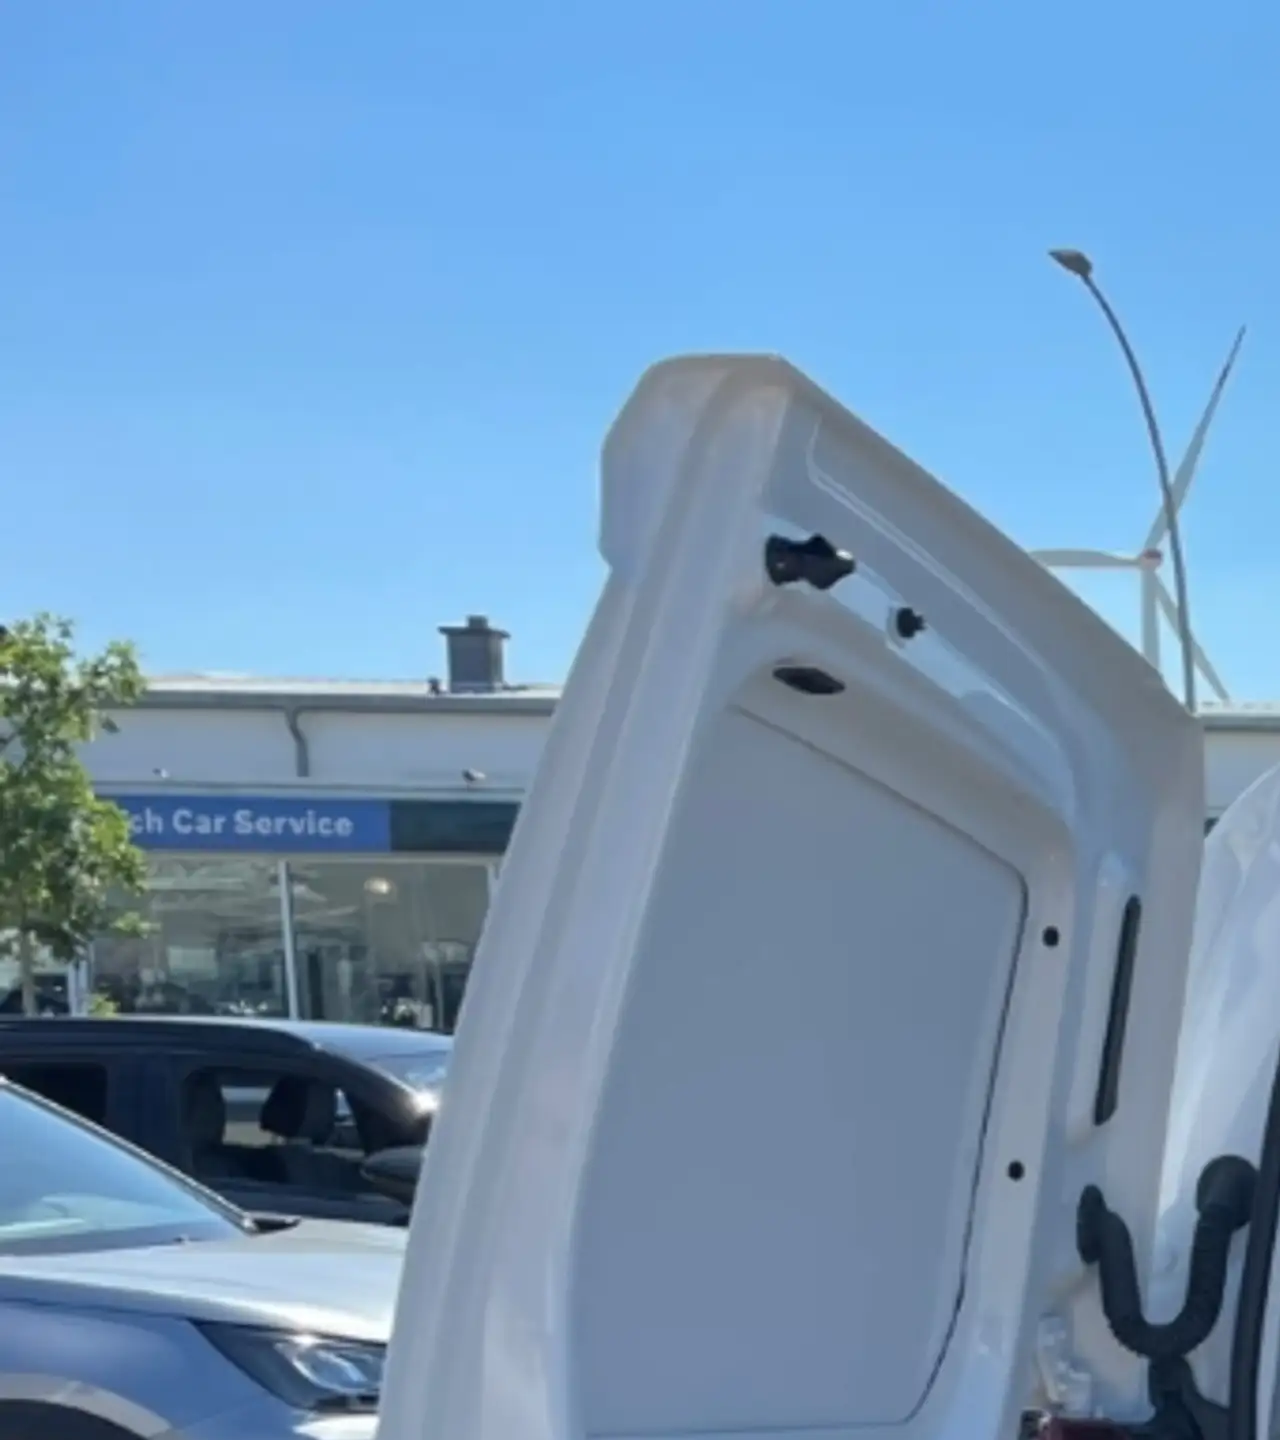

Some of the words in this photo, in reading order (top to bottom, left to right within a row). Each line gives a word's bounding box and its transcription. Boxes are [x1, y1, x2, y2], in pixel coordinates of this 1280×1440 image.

[123, 807, 163, 834] ch
[172, 809, 227, 835] Car
[233, 809, 354, 837] Service
